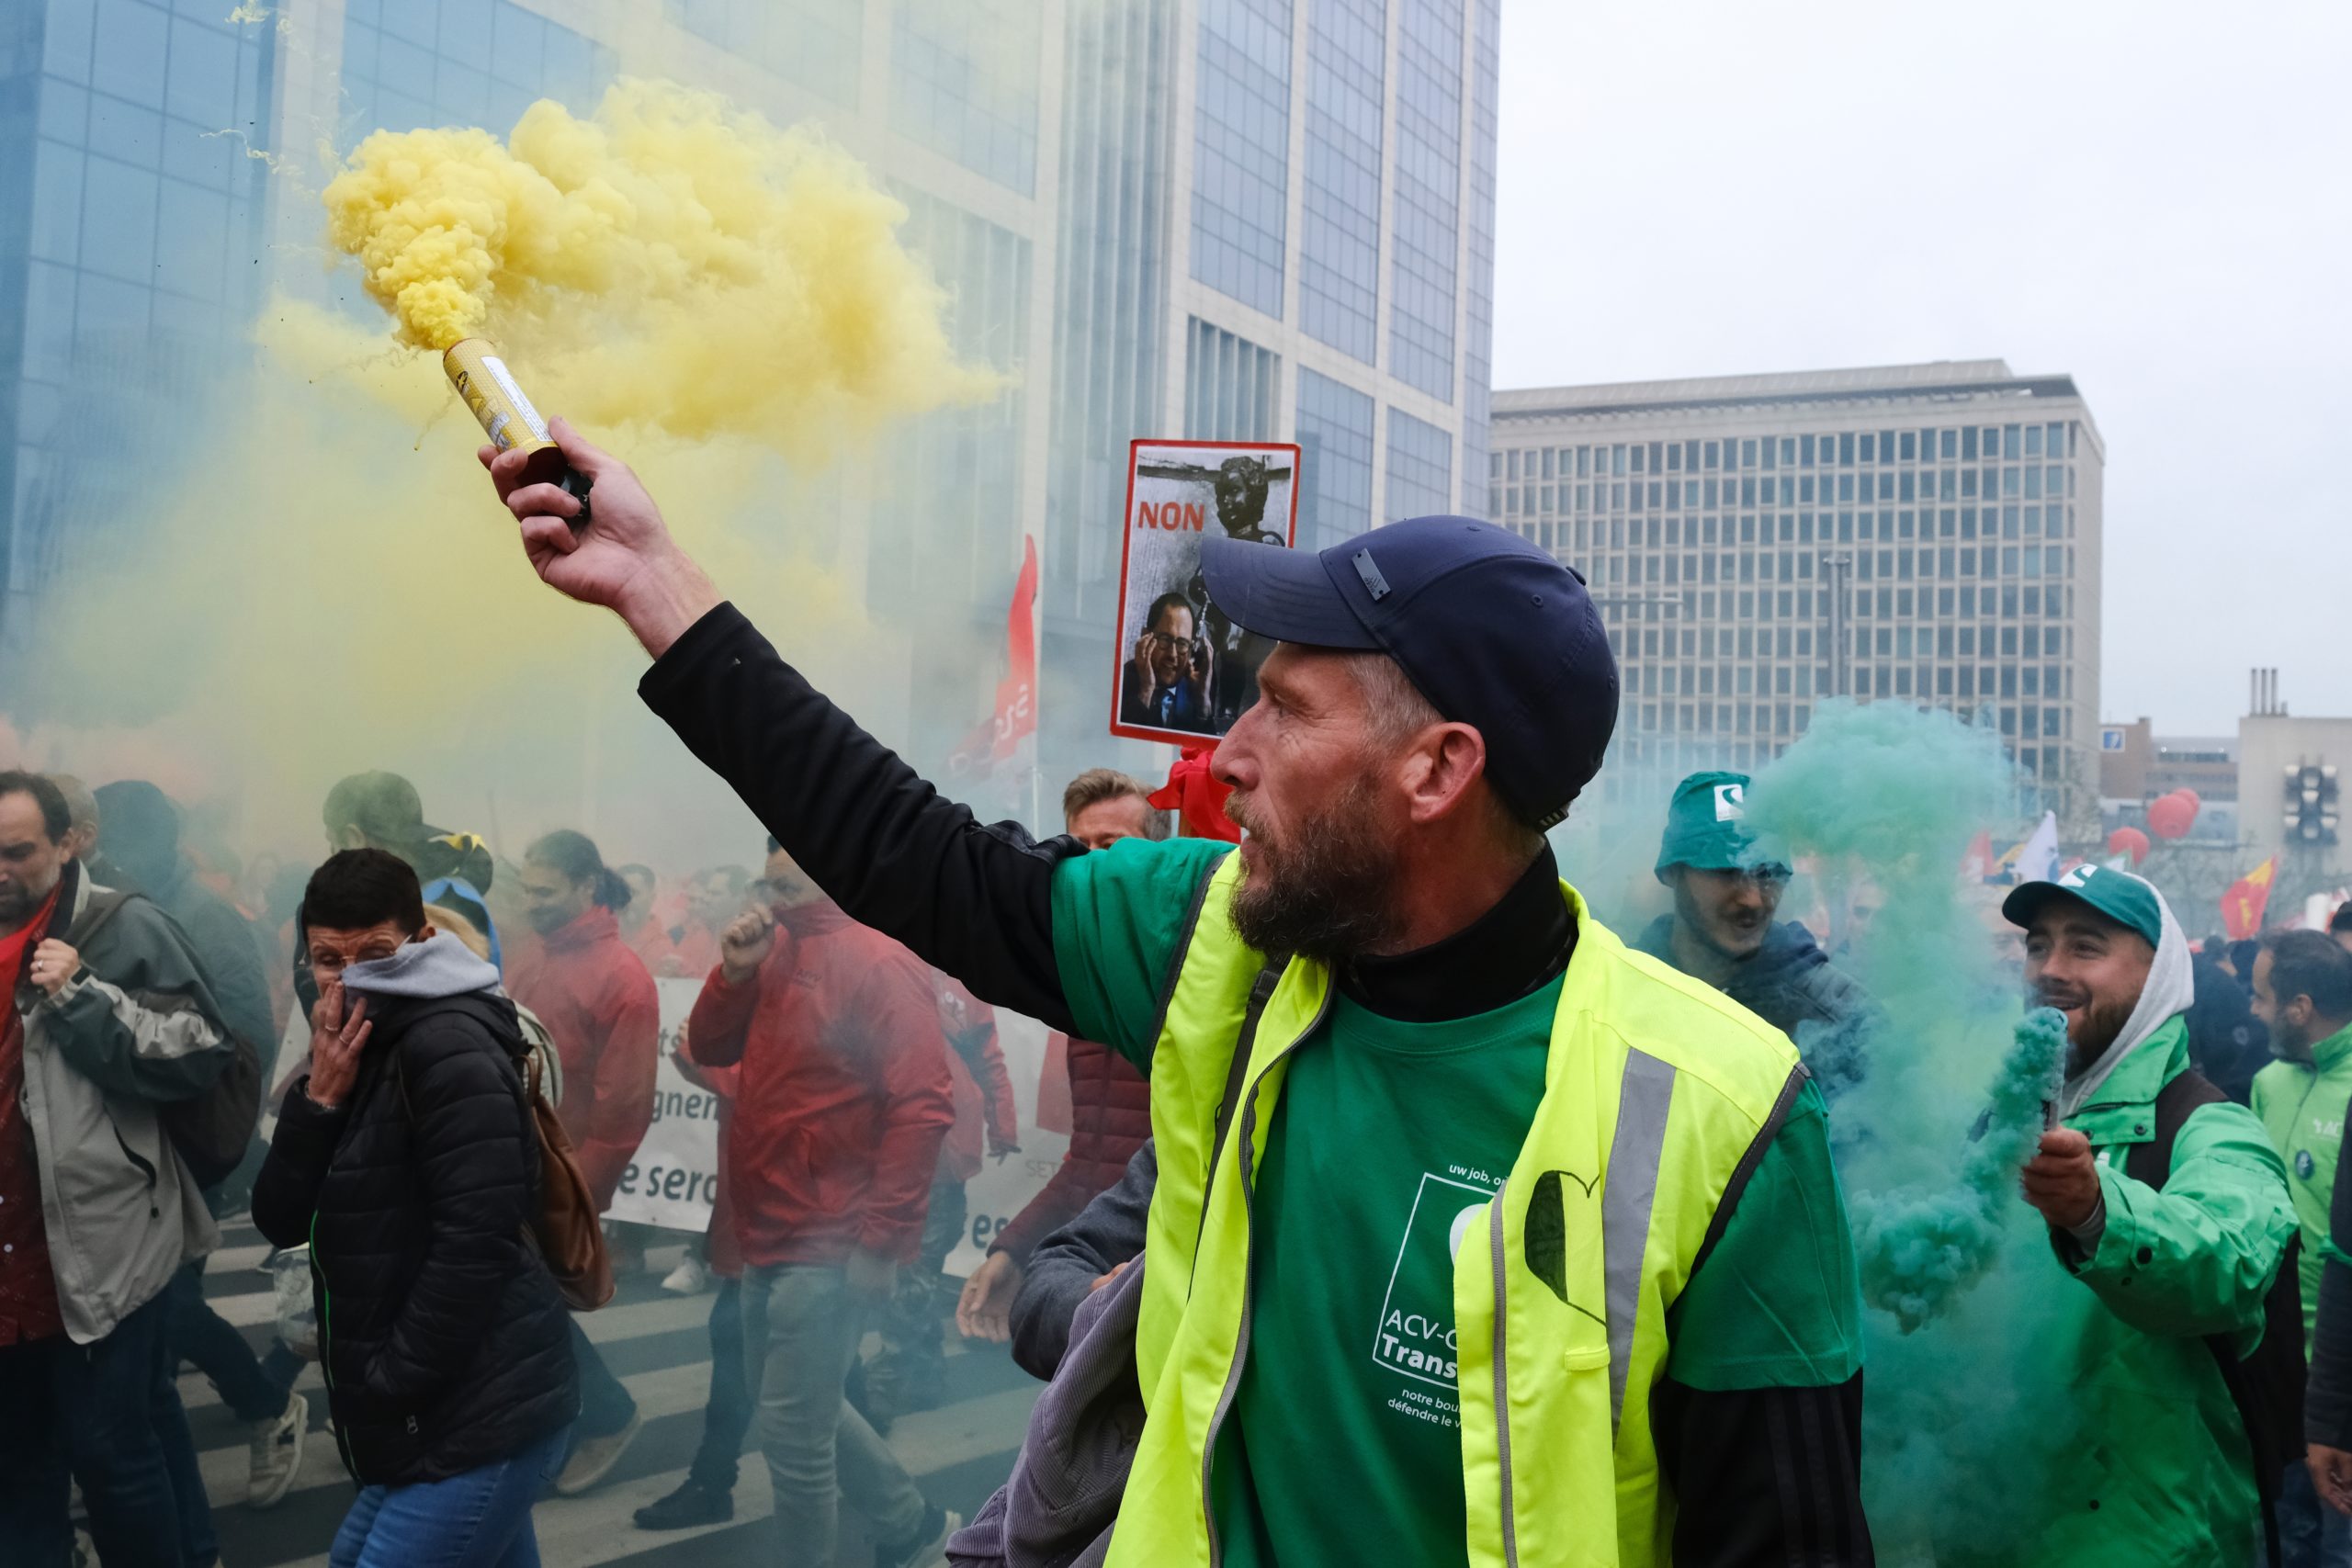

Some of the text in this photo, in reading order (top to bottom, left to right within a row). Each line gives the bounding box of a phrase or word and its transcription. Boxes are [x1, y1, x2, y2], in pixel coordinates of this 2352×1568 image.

[1137, 501, 1205, 533] NON
[1449, 1164, 1467, 1177] uw
[1466, 1167, 1490, 1184] job,
[1382, 1332, 1458, 1379] Trans
[1387, 1397, 1439, 1424] défendre
[1441, 1415, 1453, 1427] le
[1401, 1388, 1433, 1406] notre
